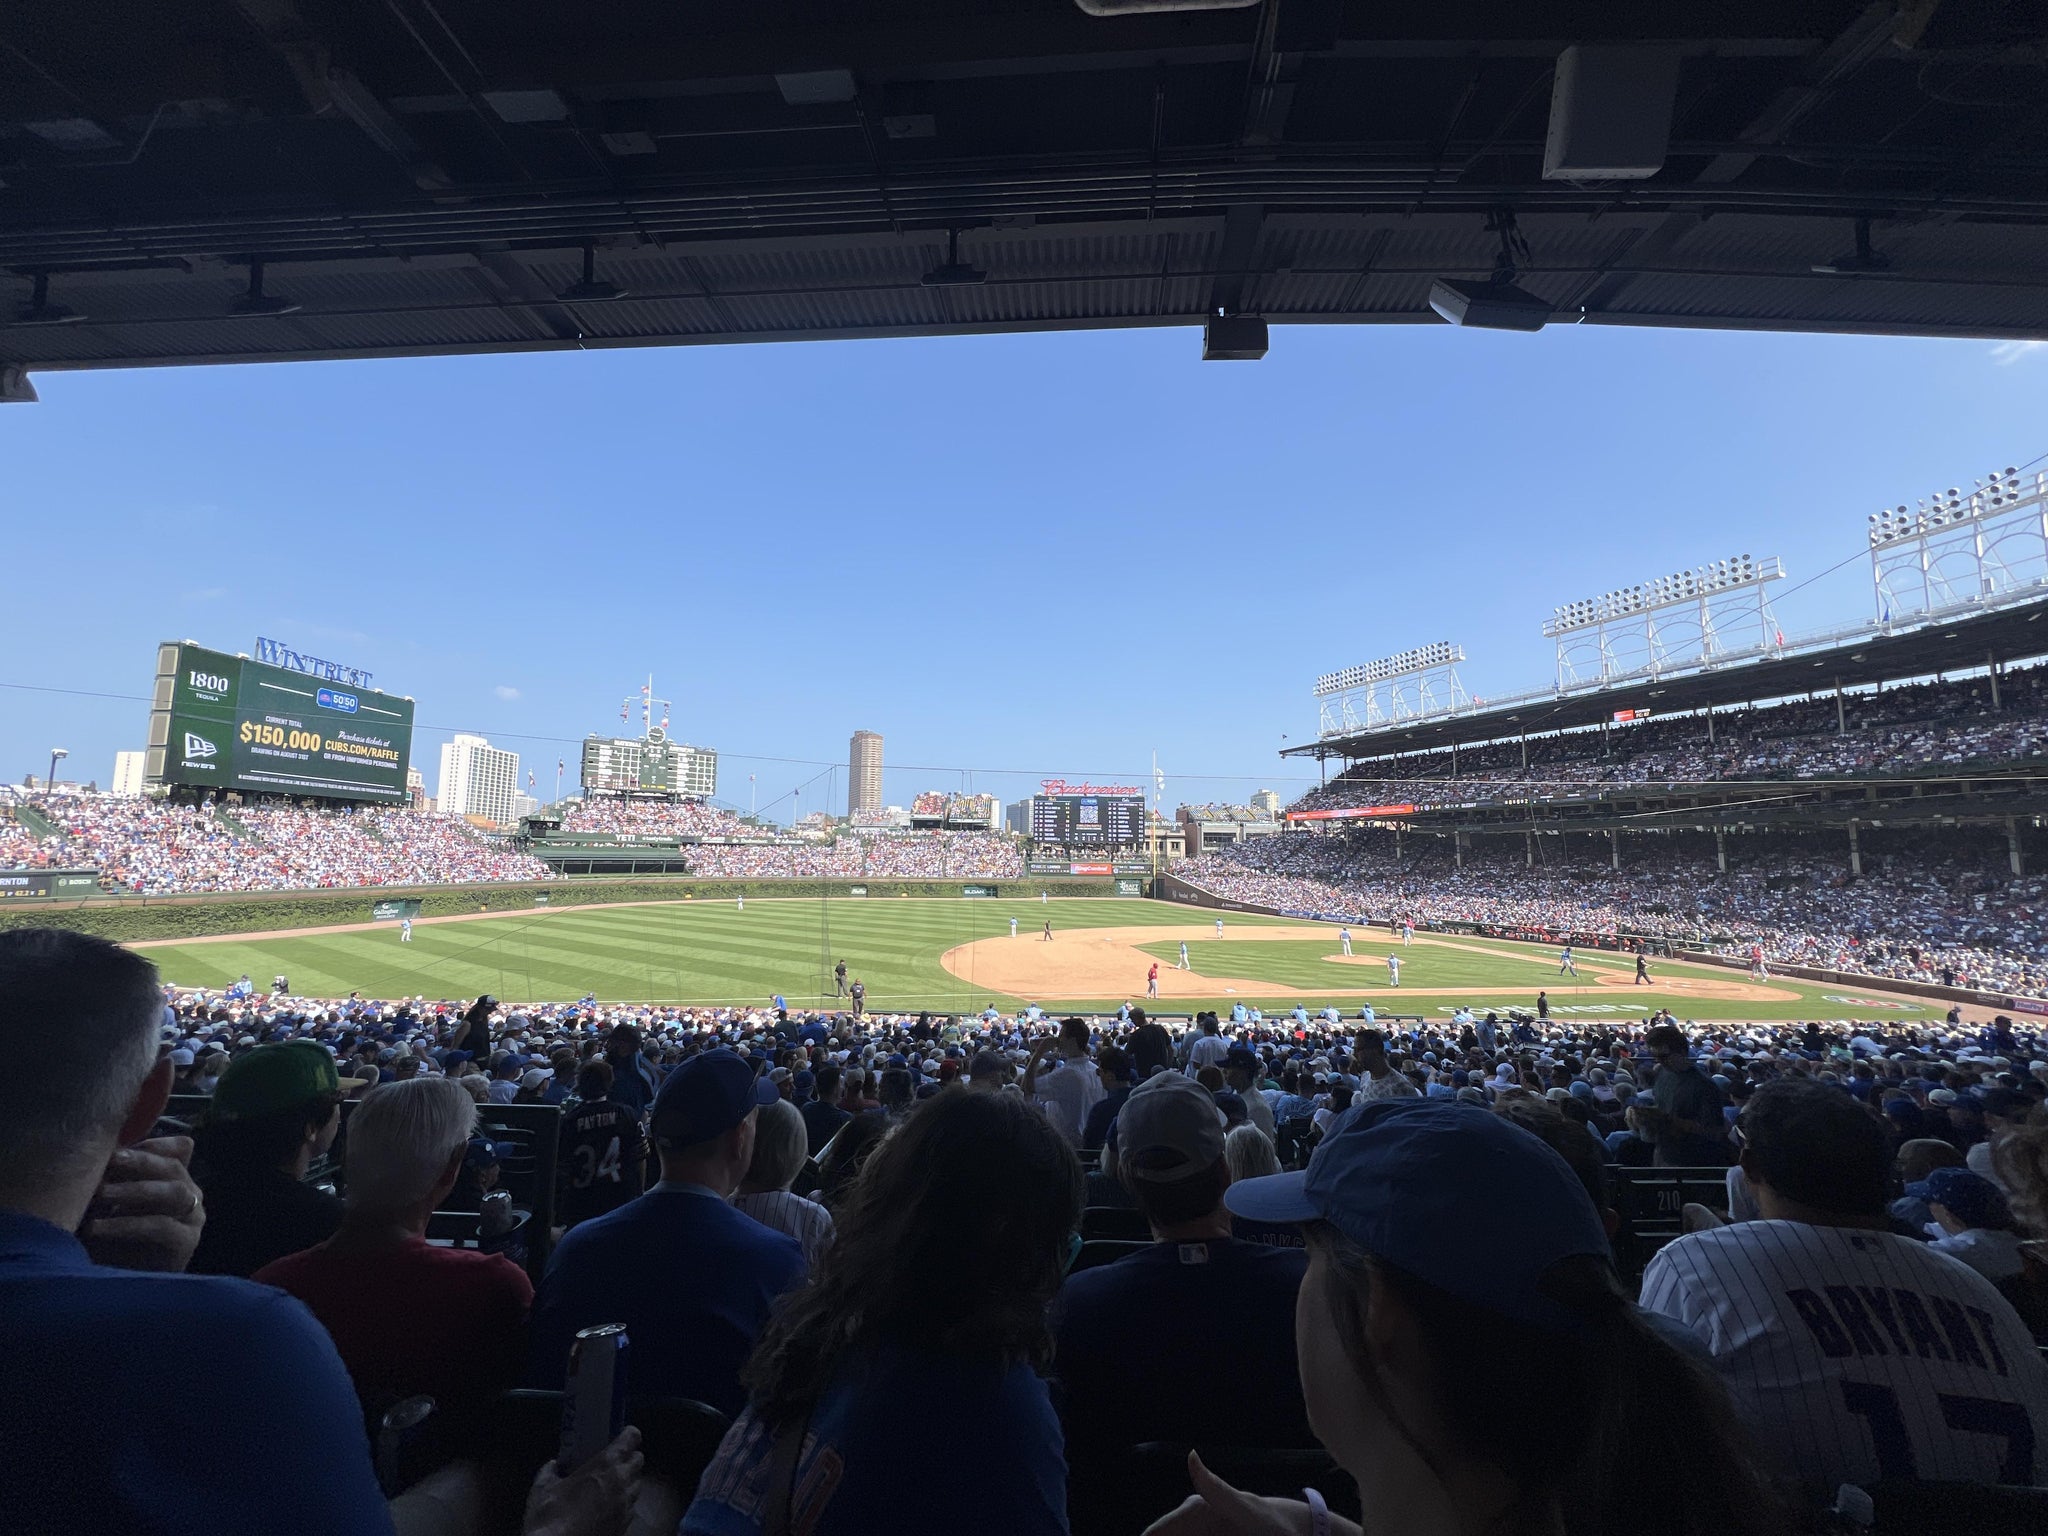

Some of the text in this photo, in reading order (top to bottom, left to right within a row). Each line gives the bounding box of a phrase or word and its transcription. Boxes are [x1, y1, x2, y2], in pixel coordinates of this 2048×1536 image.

[256, 636, 374, 689] WINTRUST
[189, 670, 229, 692] 1800
[195, 692, 219, 702] TEQUILA
[265, 715, 303, 729] CURRENT TOTAL
[240, 720, 321, 752] $150,000
[337, 730, 366, 743] Purchase
[365, 736, 383, 746] tickets
[250, 747, 273, 756] DRAWING
[280, 751, 298, 759] AUGUST
[325, 740, 399, 761] CUBS.COM/RAFFLE
[331, 754, 346, 762] FROM
[346, 755, 373, 766] UNIFORMED
[372, 759, 398, 770] PERSONNEL
[1040, 778, 1138, 796] Budweiser
[615, 834, 636, 842] YETI
[571, 1135, 622, 1189] 34
[1656, 1189, 1681, 1212] 210
[1785, 1285, 2010, 1378] BRYANT
[1838, 1377, 2036, 1486] 17
